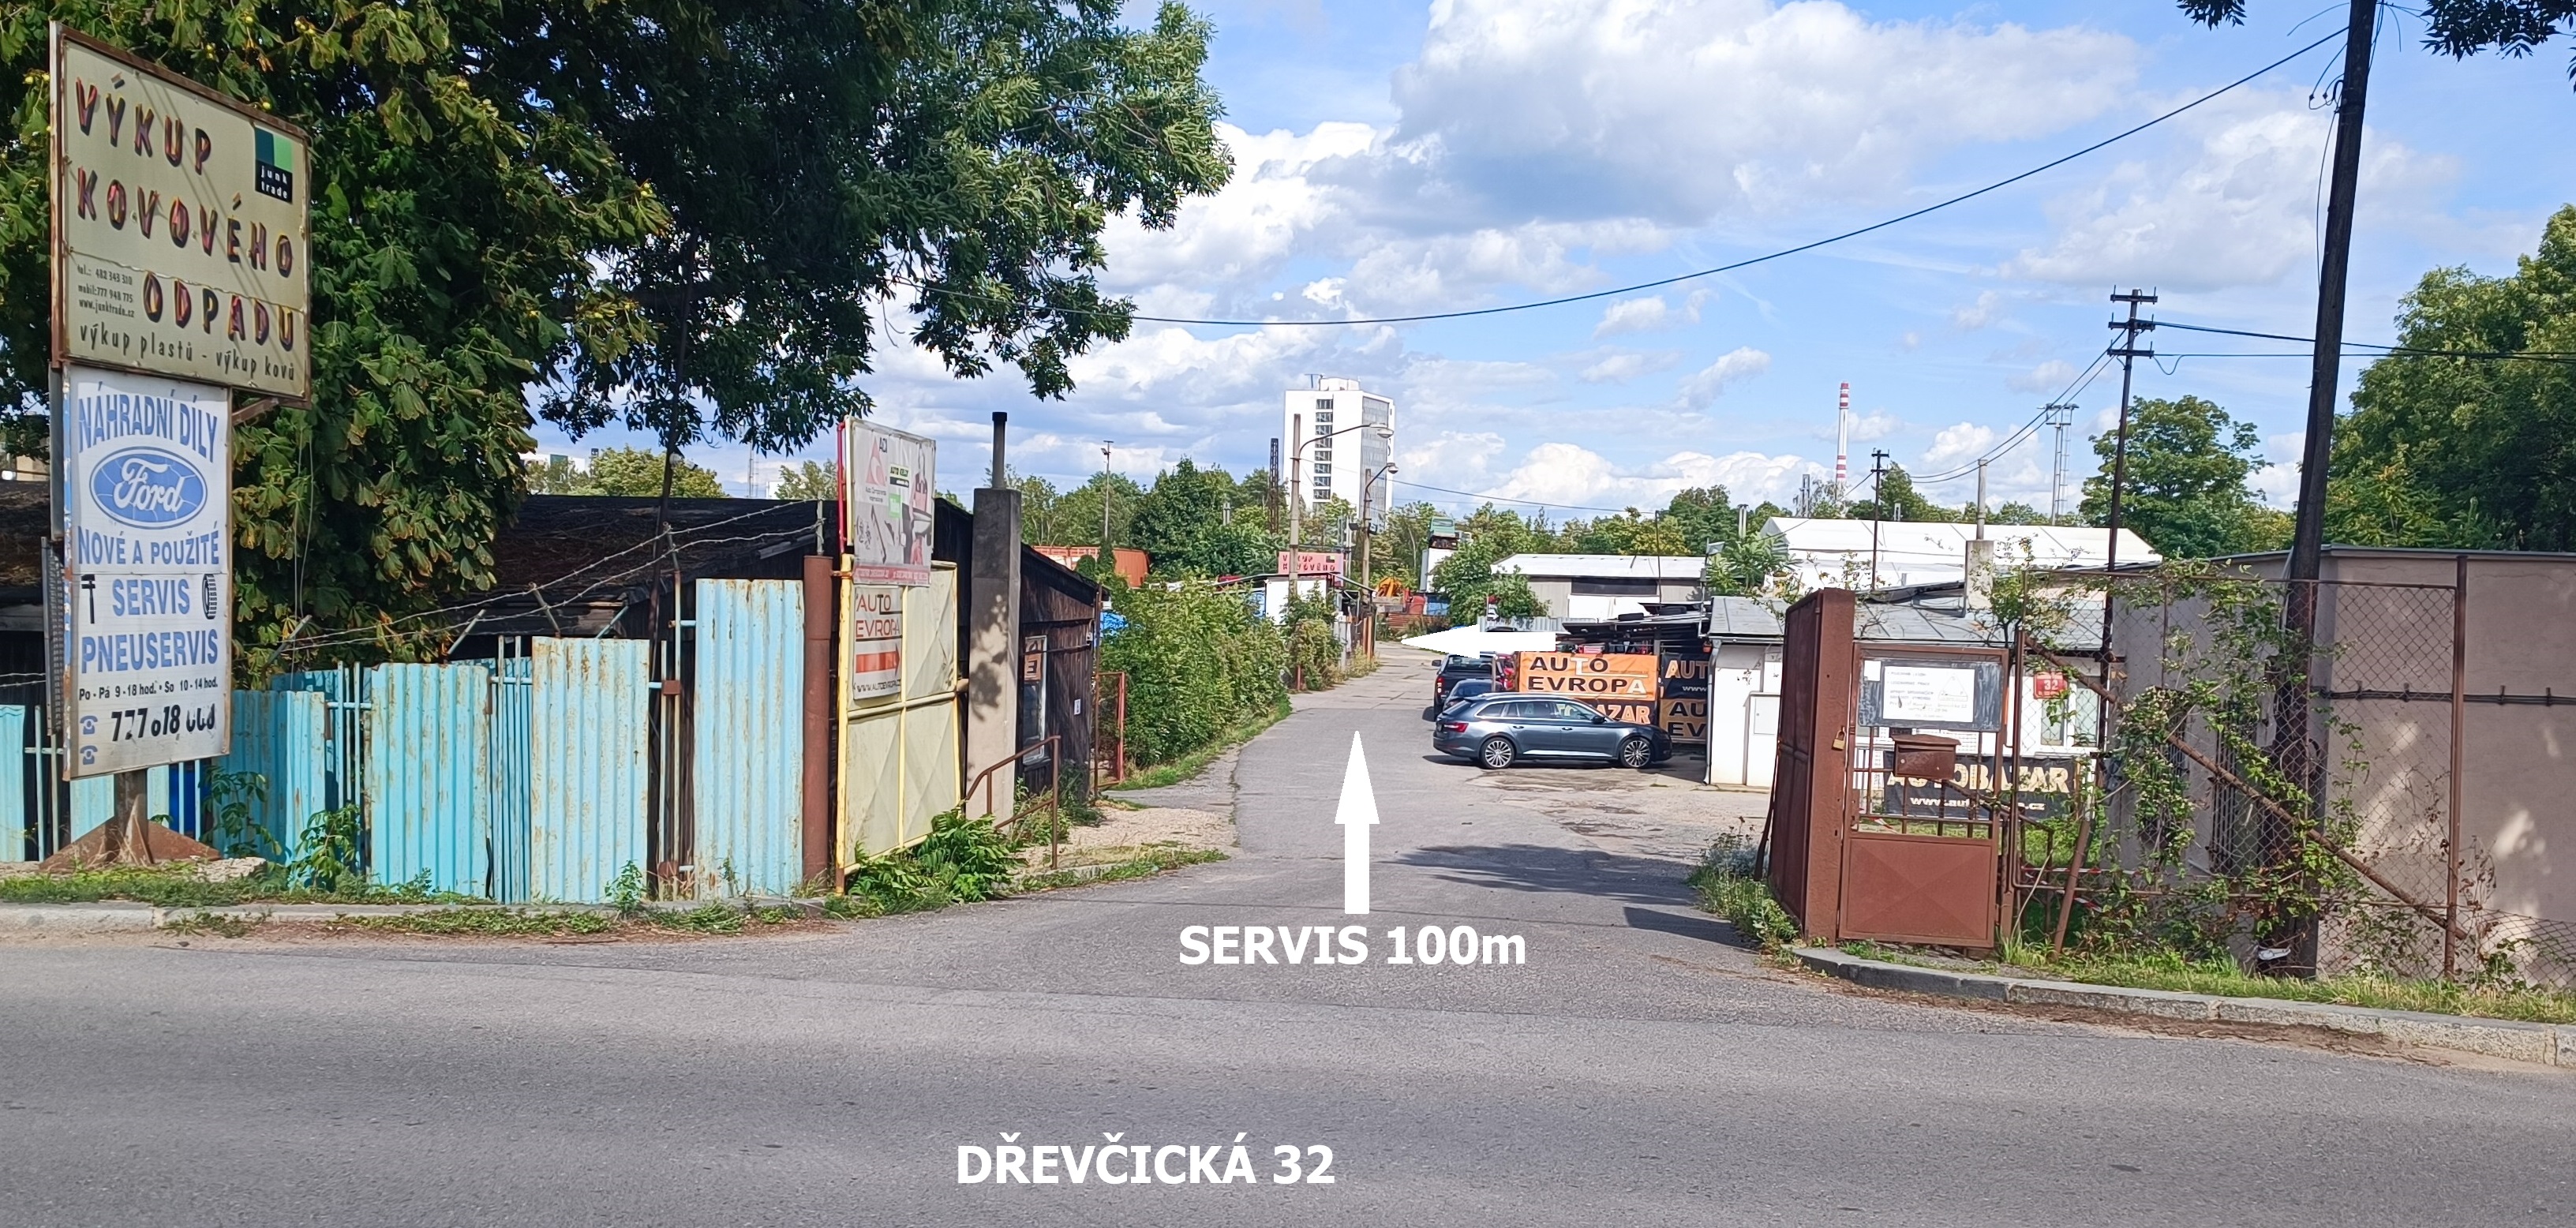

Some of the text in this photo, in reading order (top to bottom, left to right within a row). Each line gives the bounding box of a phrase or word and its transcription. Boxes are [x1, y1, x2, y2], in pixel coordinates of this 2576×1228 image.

[76, 72, 212, 175] VÝKUP
[261, 165, 287, 185] junk
[261, 181, 287, 199] trade
[77, 167, 293, 278] KOVOVÉHO
[79, 299, 135, 317] www.junktrade.cz
[143, 271, 294, 351] ODPADU
[80, 321, 129, 355] výkup
[140, 332, 193, 361] plastů
[216, 350, 256, 376] výkup
[265, 357, 294, 380] kovů
[78, 381, 218, 464] NÁHRADNÍ DÍLY
[114, 458, 185, 513] Ford
[77, 521, 219, 565] NOVÉ A POUŽITÉ
[112, 578, 190, 616] SERVIS
[856, 594, 892, 615] AUTO
[856, 619, 900, 638] EVROPA
[81, 628, 218, 674] PNEUSERVIS
[1530, 657, 1608, 675] AUTO
[79, 688, 91, 700] Po
[99, 685, 110, 699] Pá
[139, 682, 157, 694] hod.
[164, 680, 174, 693] So
[204, 676, 219, 688] hod.
[1528, 676, 1647, 694] EVROPA
[2043, 680, 2059, 691] 32
[111, 708, 148, 742] 777
